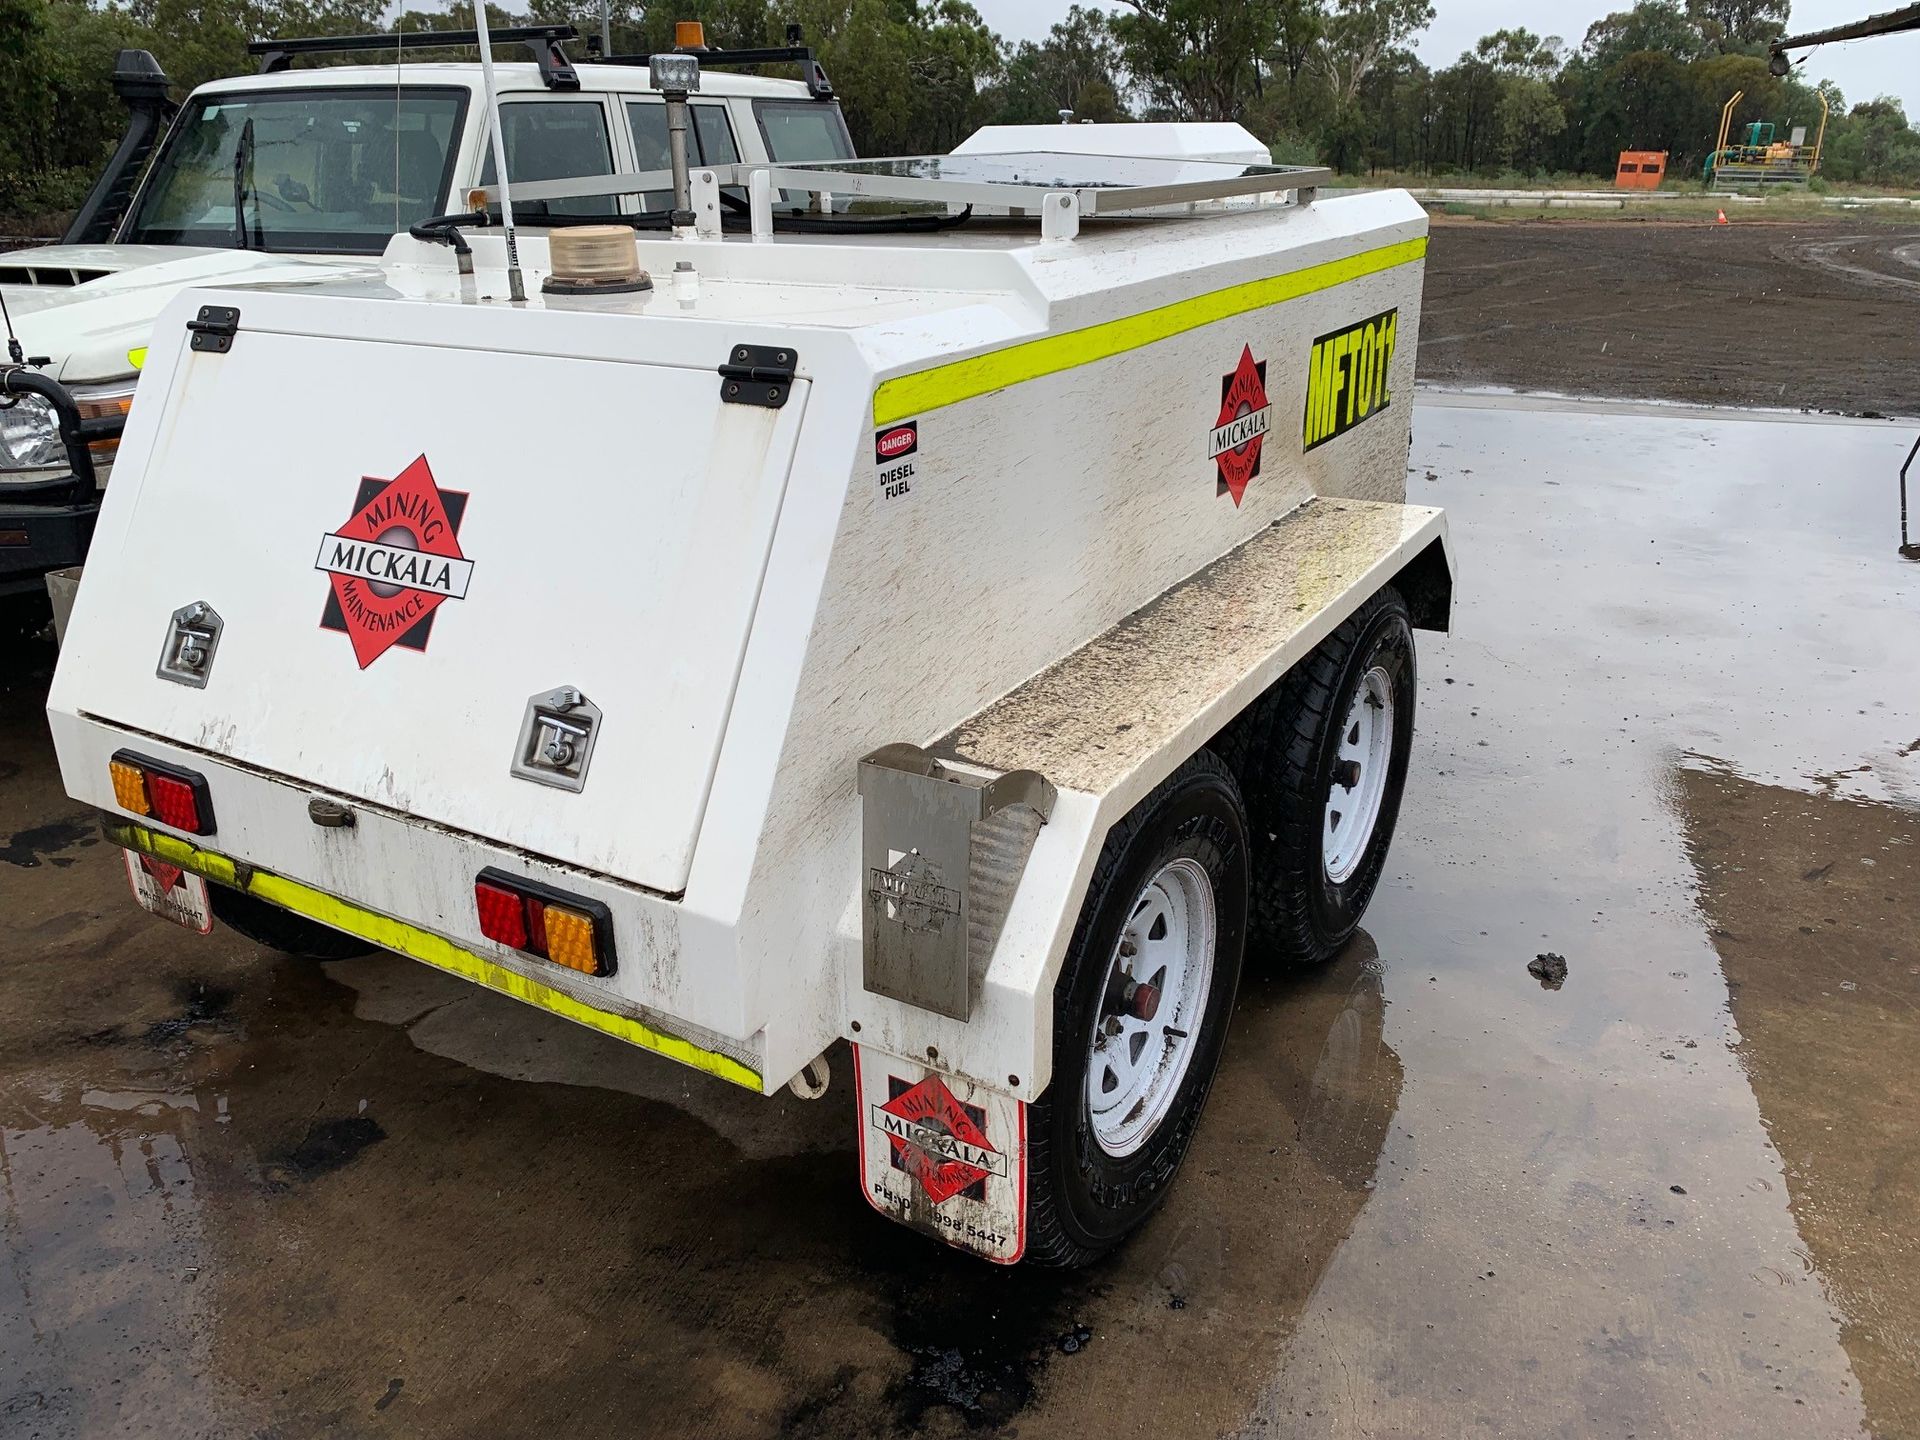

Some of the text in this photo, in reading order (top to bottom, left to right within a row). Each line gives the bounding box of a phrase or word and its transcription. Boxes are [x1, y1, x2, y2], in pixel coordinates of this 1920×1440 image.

[1227, 373, 1261, 415] MINING
[1304, 312, 1397, 447] MFT011
[881, 432, 912, 452] DANGER
[1215, 411, 1266, 452] MICKALA
[880, 463, 915, 486] DIESEL
[1222, 441, 1259, 482] MAINTENANCE
[885, 480, 910, 500] FUEL
[364, 491, 444, 544] MINING
[329, 541, 451, 591] MICKALA
[342, 578, 425, 633] MAINTENANCE
[901, 1094, 972, 1135] MINNG
[966, 1225, 1007, 1247] 5447
